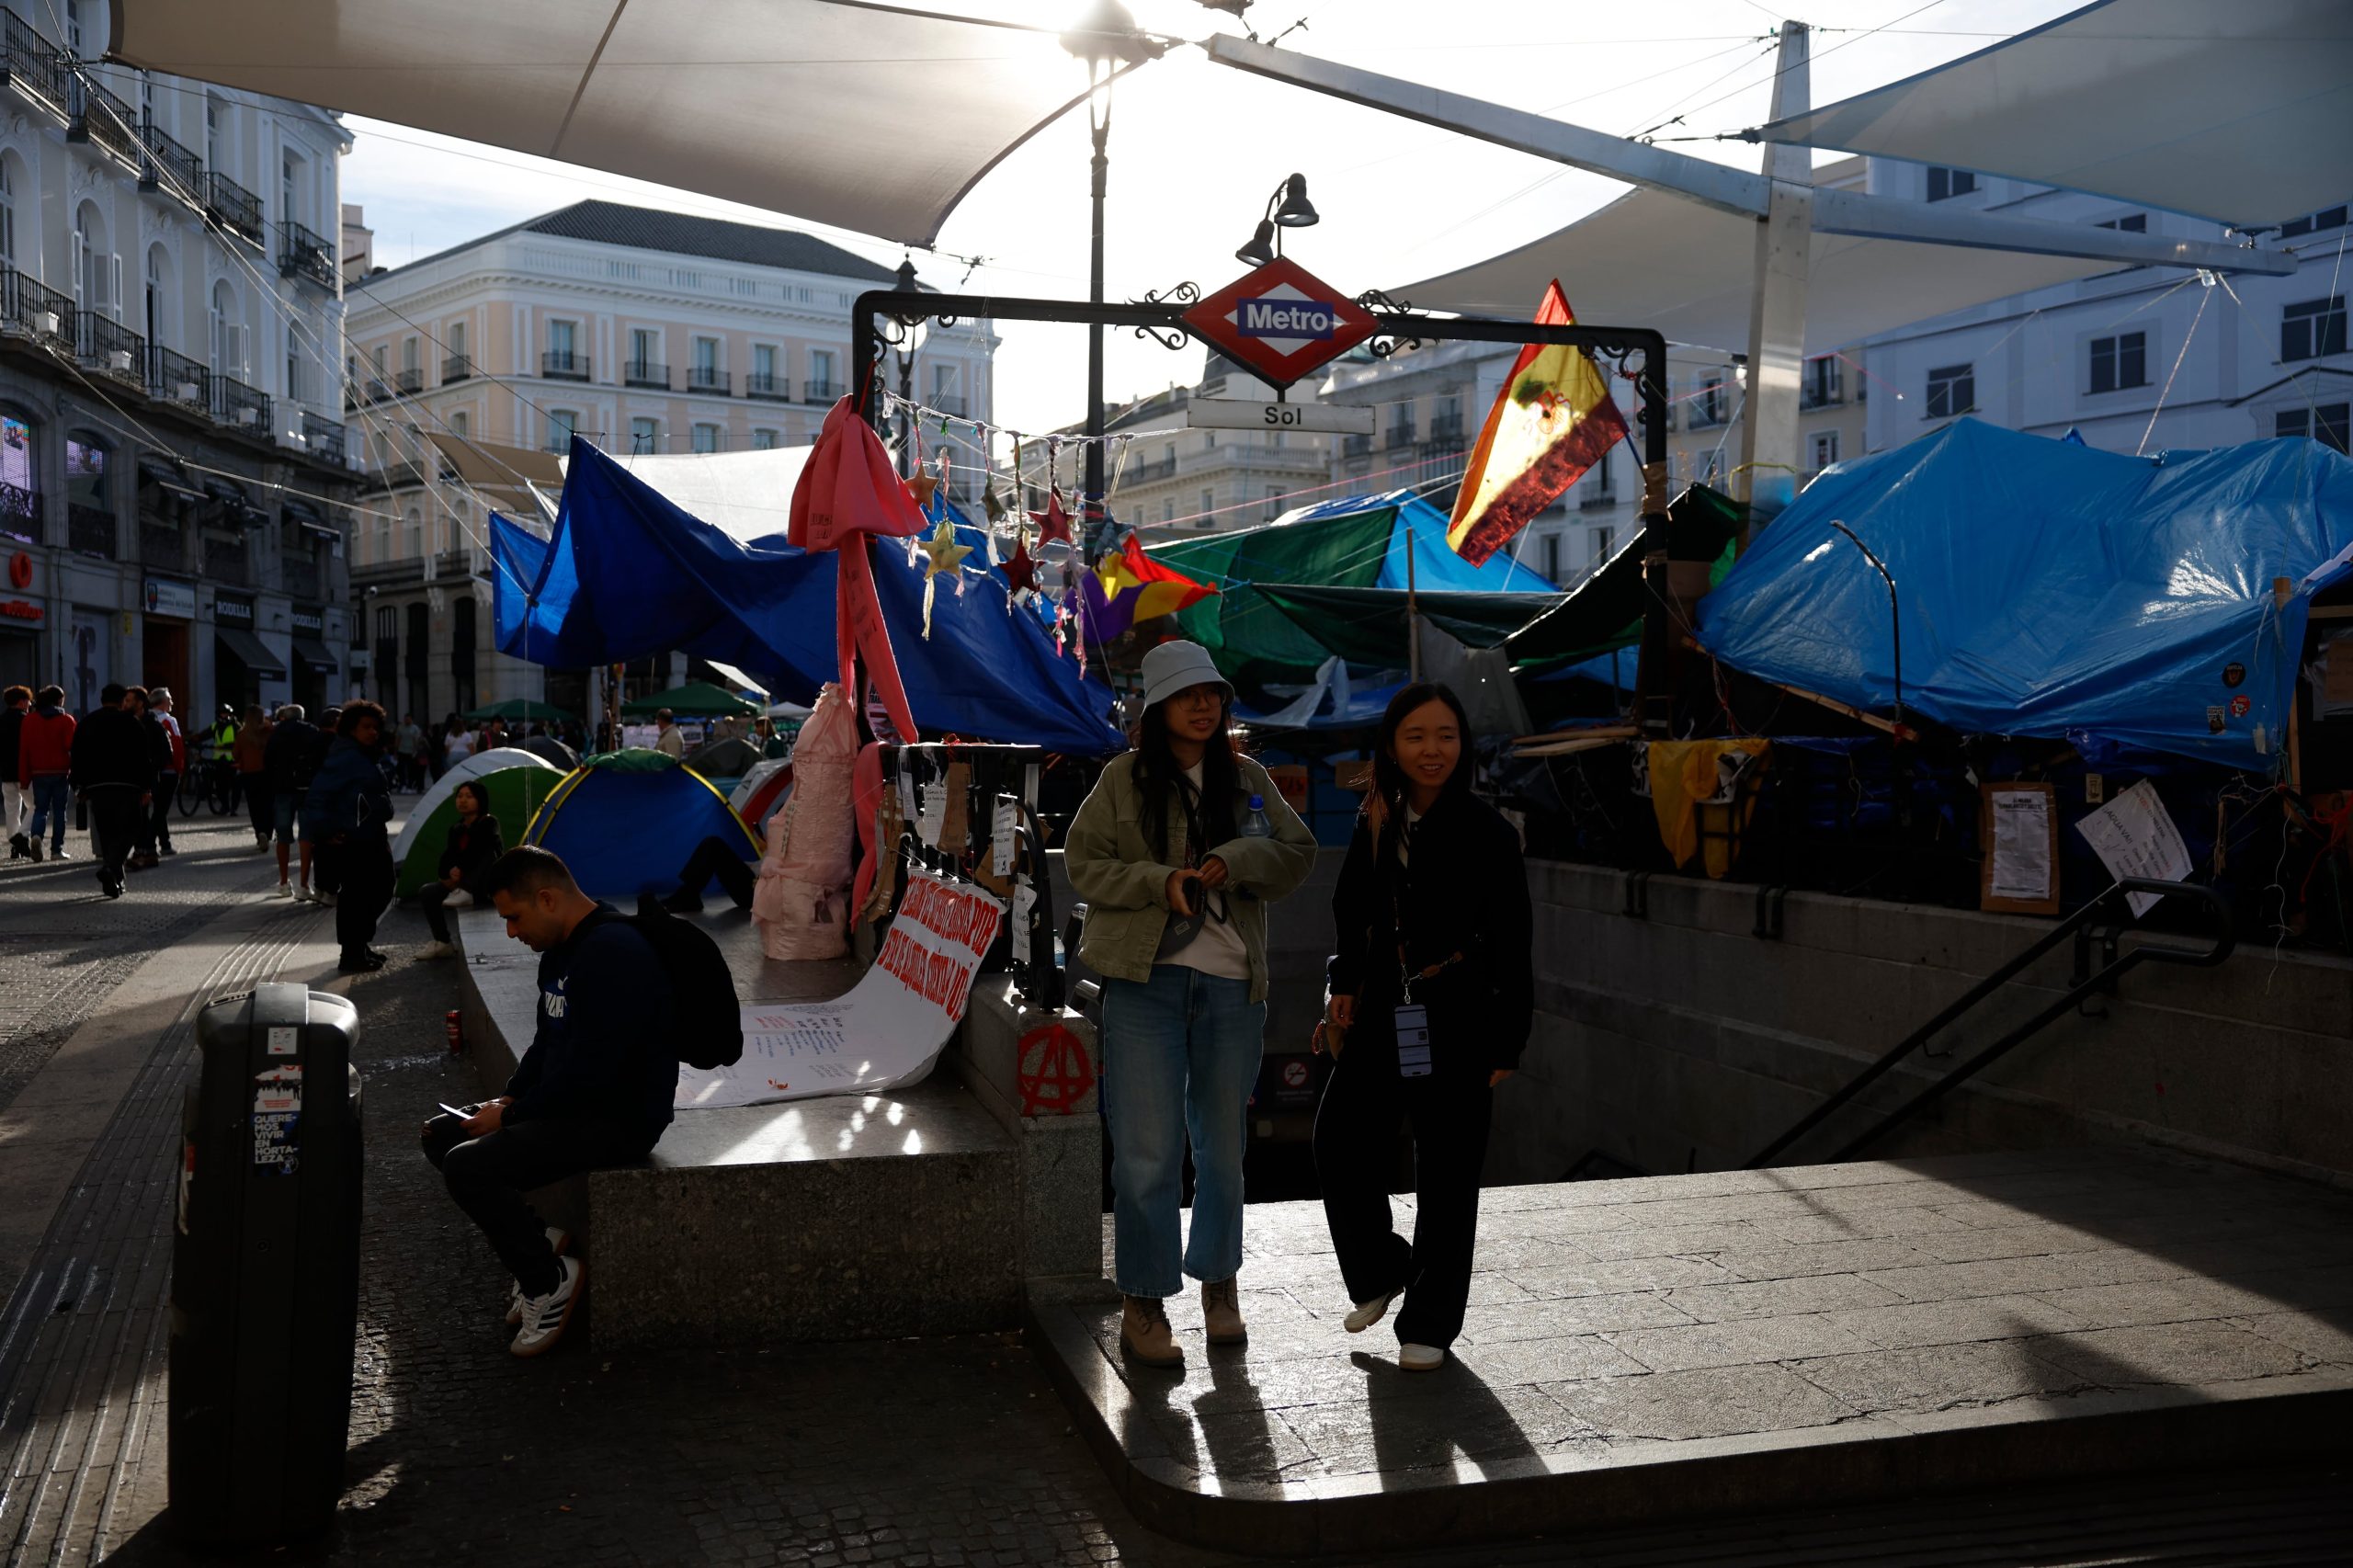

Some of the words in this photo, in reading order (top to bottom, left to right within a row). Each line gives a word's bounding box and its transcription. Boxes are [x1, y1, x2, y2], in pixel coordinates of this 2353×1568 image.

[1247, 304, 1328, 331] Metro
[1265, 406, 1301, 425] Sol
[217, 600, 251, 619] RODILLA
[291, 613, 322, 630] RODILLA
[254, 1113, 298, 1123] QUERE-
[255, 1122, 279, 1131] MOS
[255, 1131, 285, 1141] VIVIR
[255, 1140, 270, 1148] EN
[255, 1145, 299, 1156] HORTA-
[255, 1155, 285, 1165] LEZA
